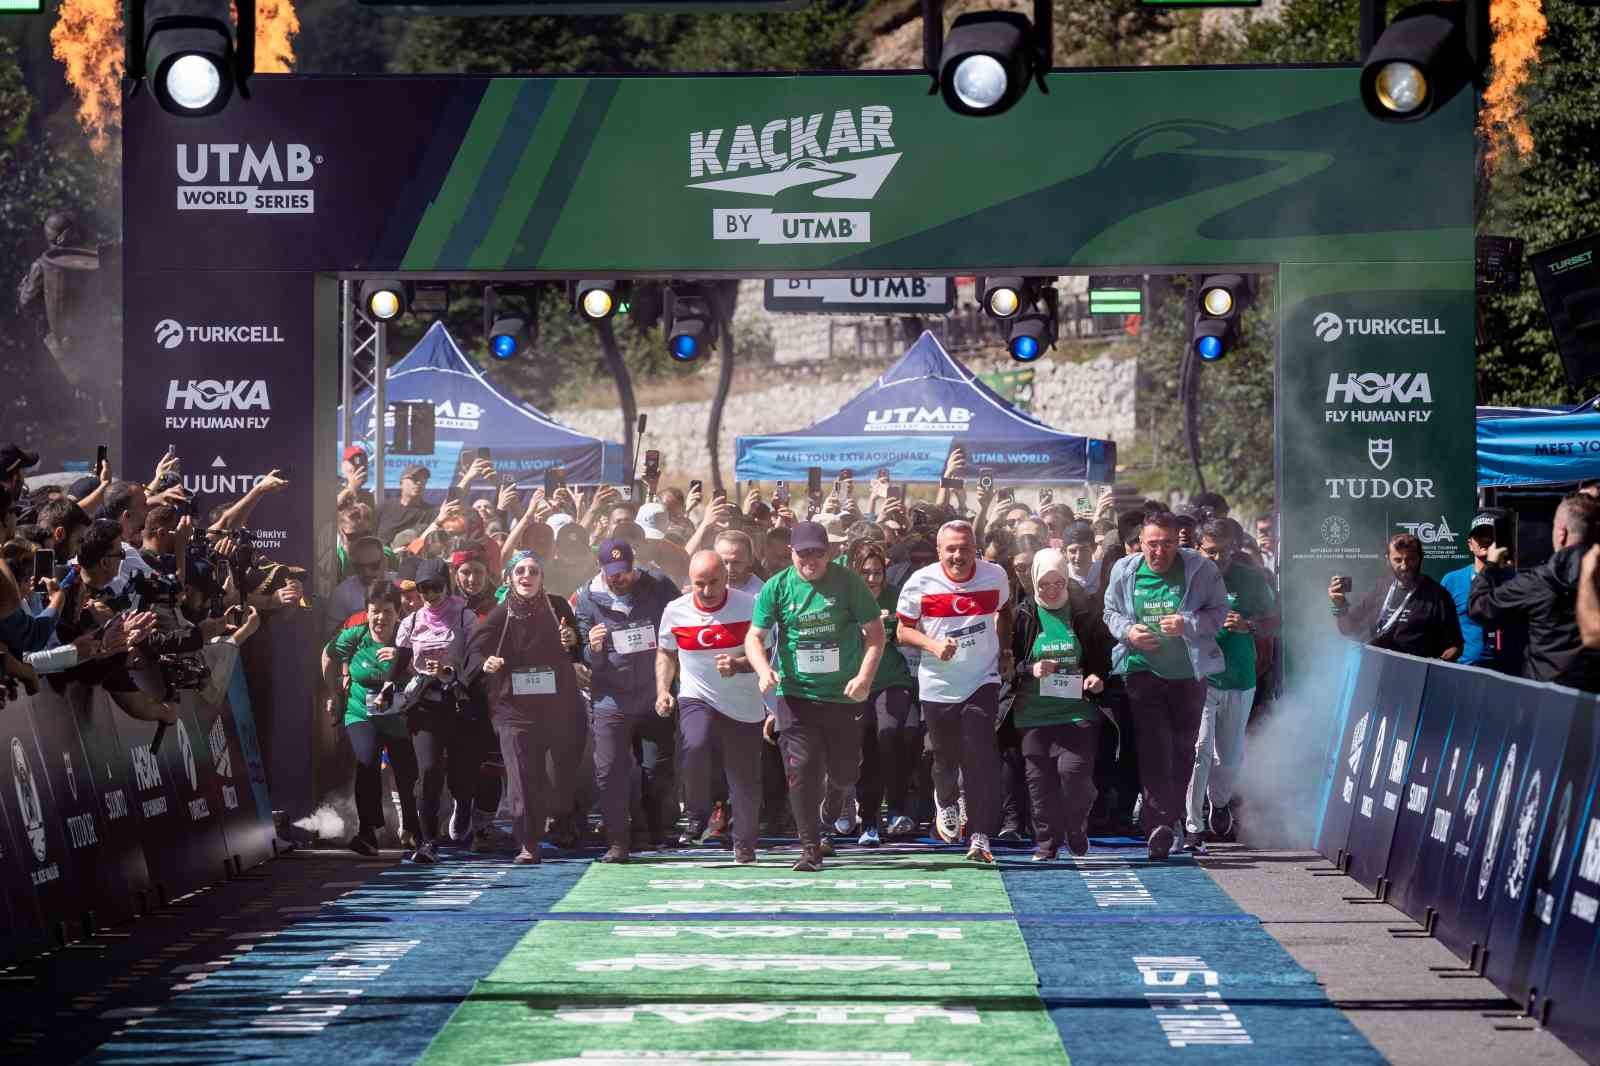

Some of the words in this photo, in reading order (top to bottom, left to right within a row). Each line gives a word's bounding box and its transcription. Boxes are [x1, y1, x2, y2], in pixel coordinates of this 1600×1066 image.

[177, 140, 314, 184] UTMB
[183, 191, 248, 205] WORLD
[255, 195, 309, 209] SERIES
[726, 215, 752, 232] BY
[782, 218, 854, 238] UTMB
[850, 277, 926, 298] UTMB
[187, 326, 284, 342] TURKCELL
[1345, 318, 1446, 335] TURKCELL
[166, 380, 271, 410] HOKA
[1325, 372, 1433, 403] HOKA
[165, 416, 188, 429] FLY
[190, 416, 245, 429] HUMAN
[247, 416, 270, 429] FLY
[866, 406, 971, 423] UTMB
[1325, 410, 1348, 422] FLY
[1351, 410, 1406, 422] HUMAN
[1409, 410, 1432, 422] FLY
[1535, 442, 1574, 456] MEET
[806, 453, 836, 463] YOUR
[970, 453, 1051, 465] UTMB.WORLD
[183, 474, 266, 494] UUNT
[1325, 478, 1436, 499] TUDOR
[256, 528, 288, 539] ÜRKİYE
[1396, 515, 1459, 543] TGA
[250, 541, 281, 550] YOUTH
